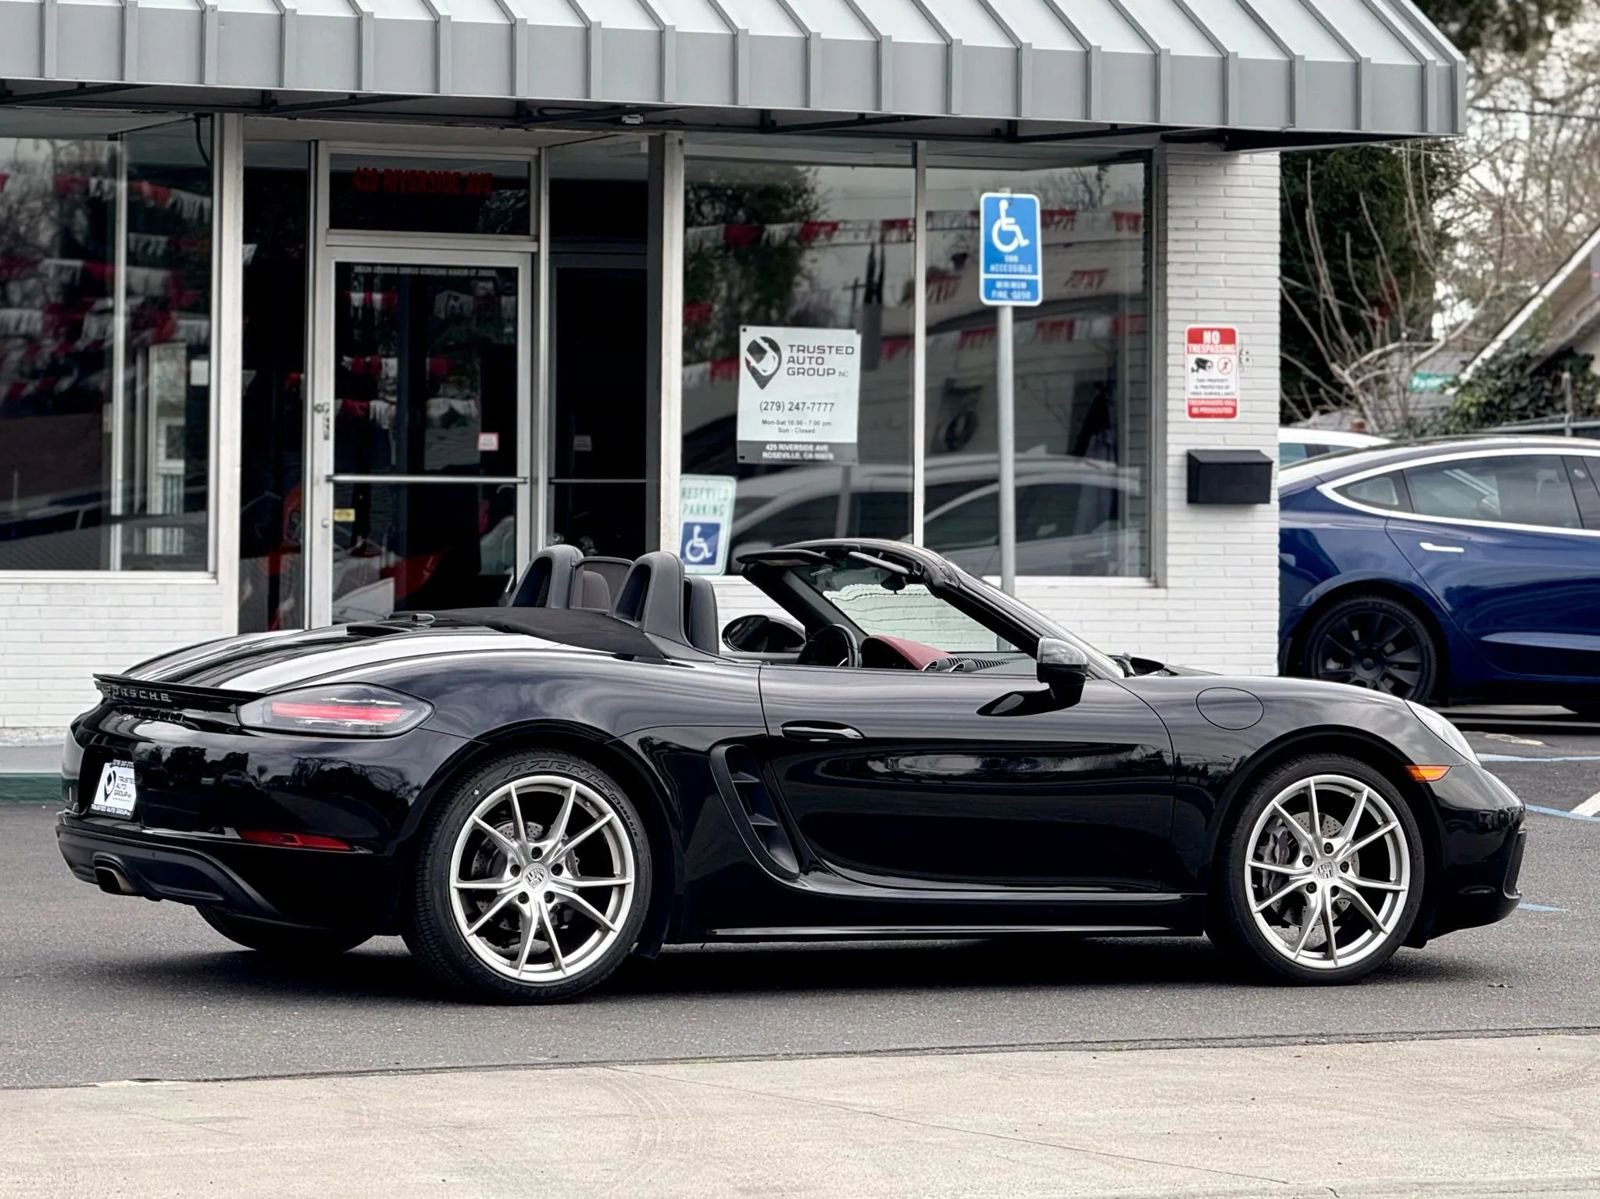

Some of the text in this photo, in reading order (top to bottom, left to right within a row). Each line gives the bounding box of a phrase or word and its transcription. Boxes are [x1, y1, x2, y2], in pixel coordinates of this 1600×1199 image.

[990, 263, 1033, 273] ACCESSIBLE
[1203, 329, 1220, 345] NO
[787, 344, 856, 356] TRUSTED
[1187, 343, 1237, 354] TRESPASSING
[786, 355, 825, 366] AUTO
[786, 366, 837, 377] GROUP
[759, 400, 835, 413] (279) 247-7777
[778, 443, 814, 452] RIVERSIDE
[815, 444, 829, 453] AVE
[682, 503, 725, 517] PARKING
[503, 759, 615, 796] AZENIS
